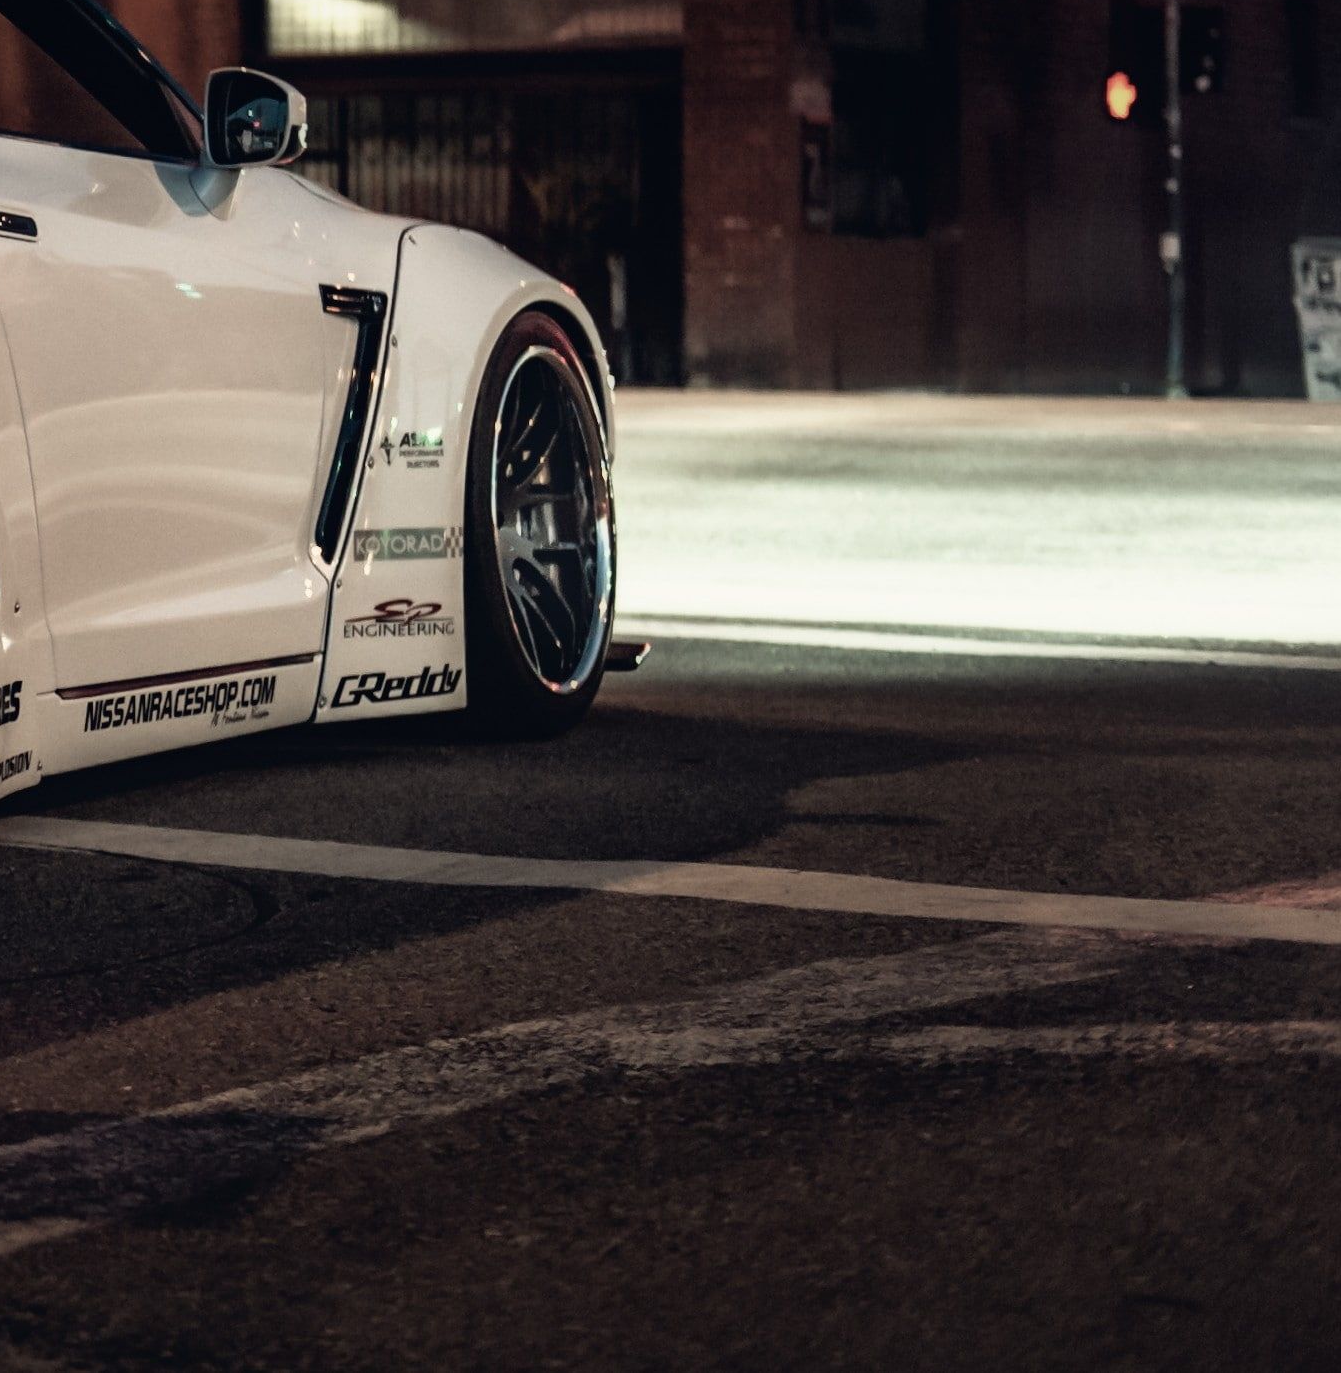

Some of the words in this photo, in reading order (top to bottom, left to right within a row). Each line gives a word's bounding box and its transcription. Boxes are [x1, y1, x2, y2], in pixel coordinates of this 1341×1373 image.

[355, 534, 445, 555] KOYORAD
[344, 621, 455, 639] ENGINEERING
[330, 664, 463, 709] GReddy
[84, 676, 276, 732] NISSANRACESHOP.COM
